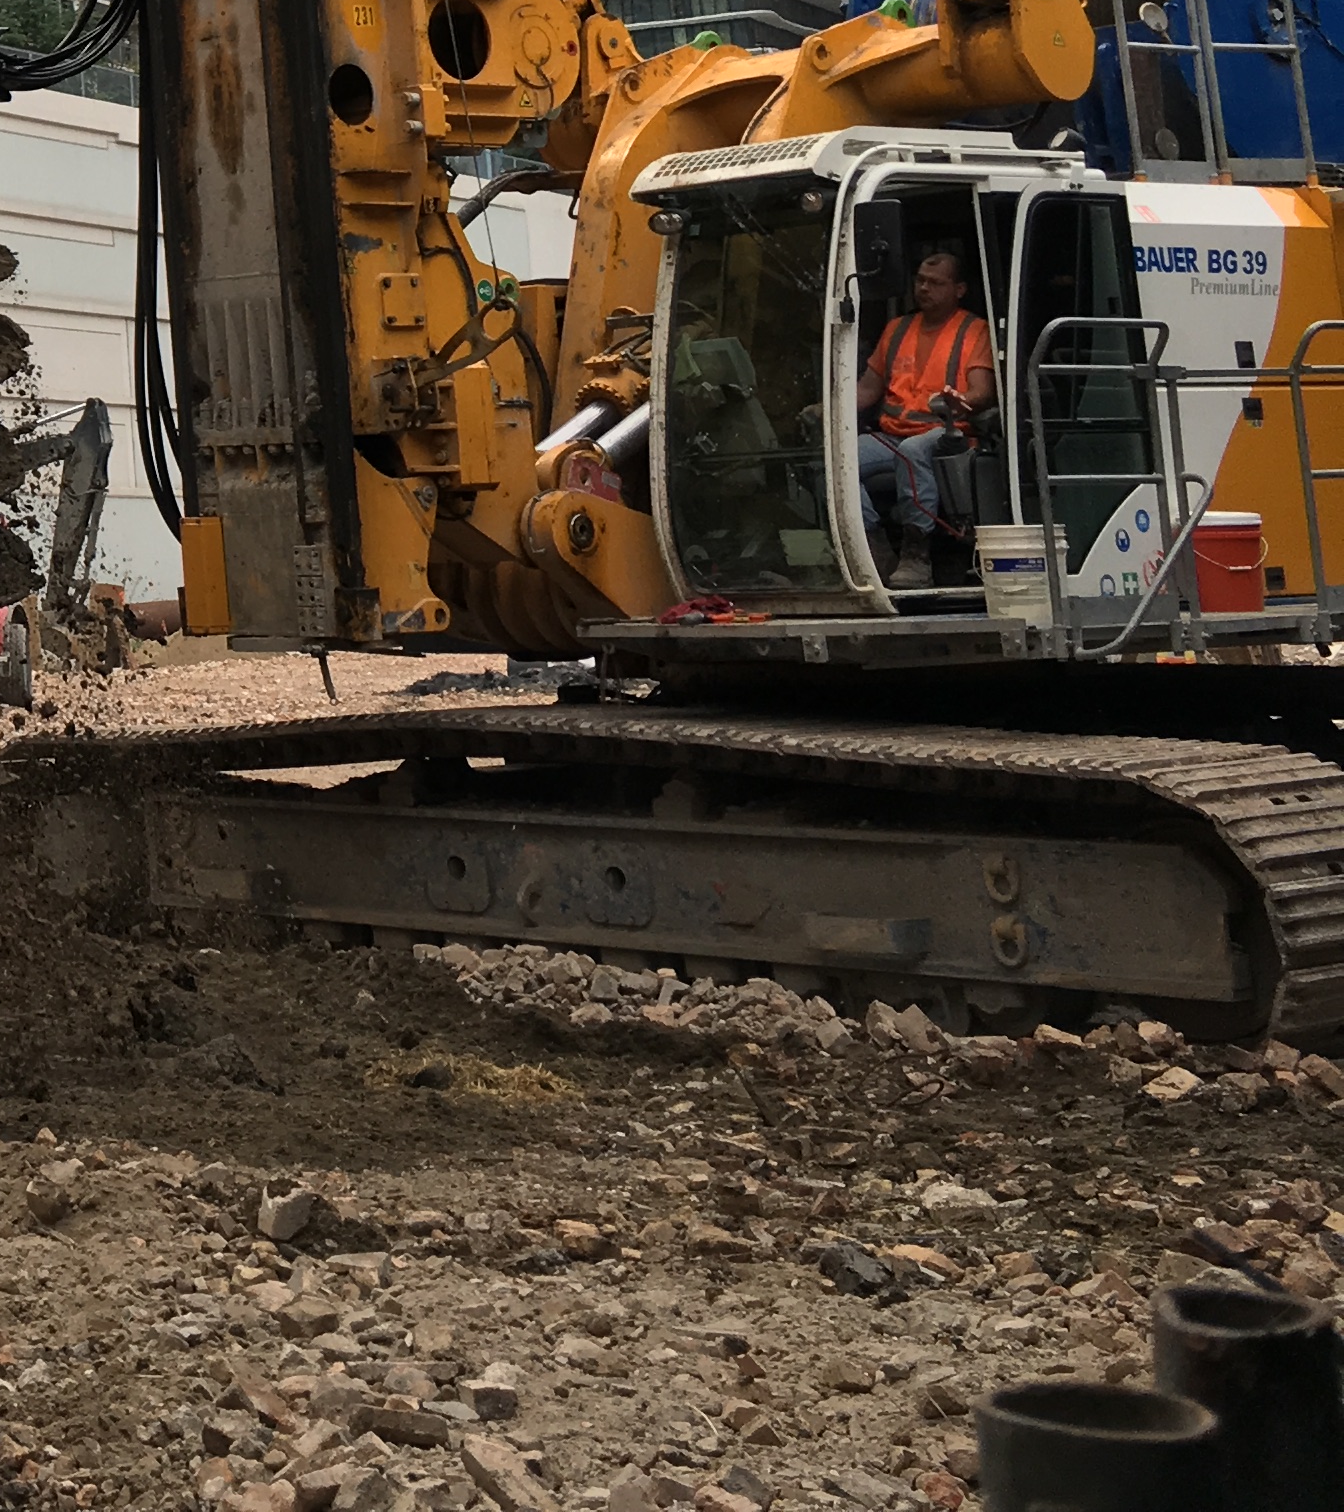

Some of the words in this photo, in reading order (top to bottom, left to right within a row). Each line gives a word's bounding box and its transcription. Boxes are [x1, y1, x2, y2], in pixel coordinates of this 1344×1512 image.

[354, 6, 374, 26] 231
[1133, 246, 1200, 274] BAUER
[1207, 249, 1238, 275] BG
[1242, 250, 1268, 275] 39
[1190, 277, 1279, 297] PremiumLine
